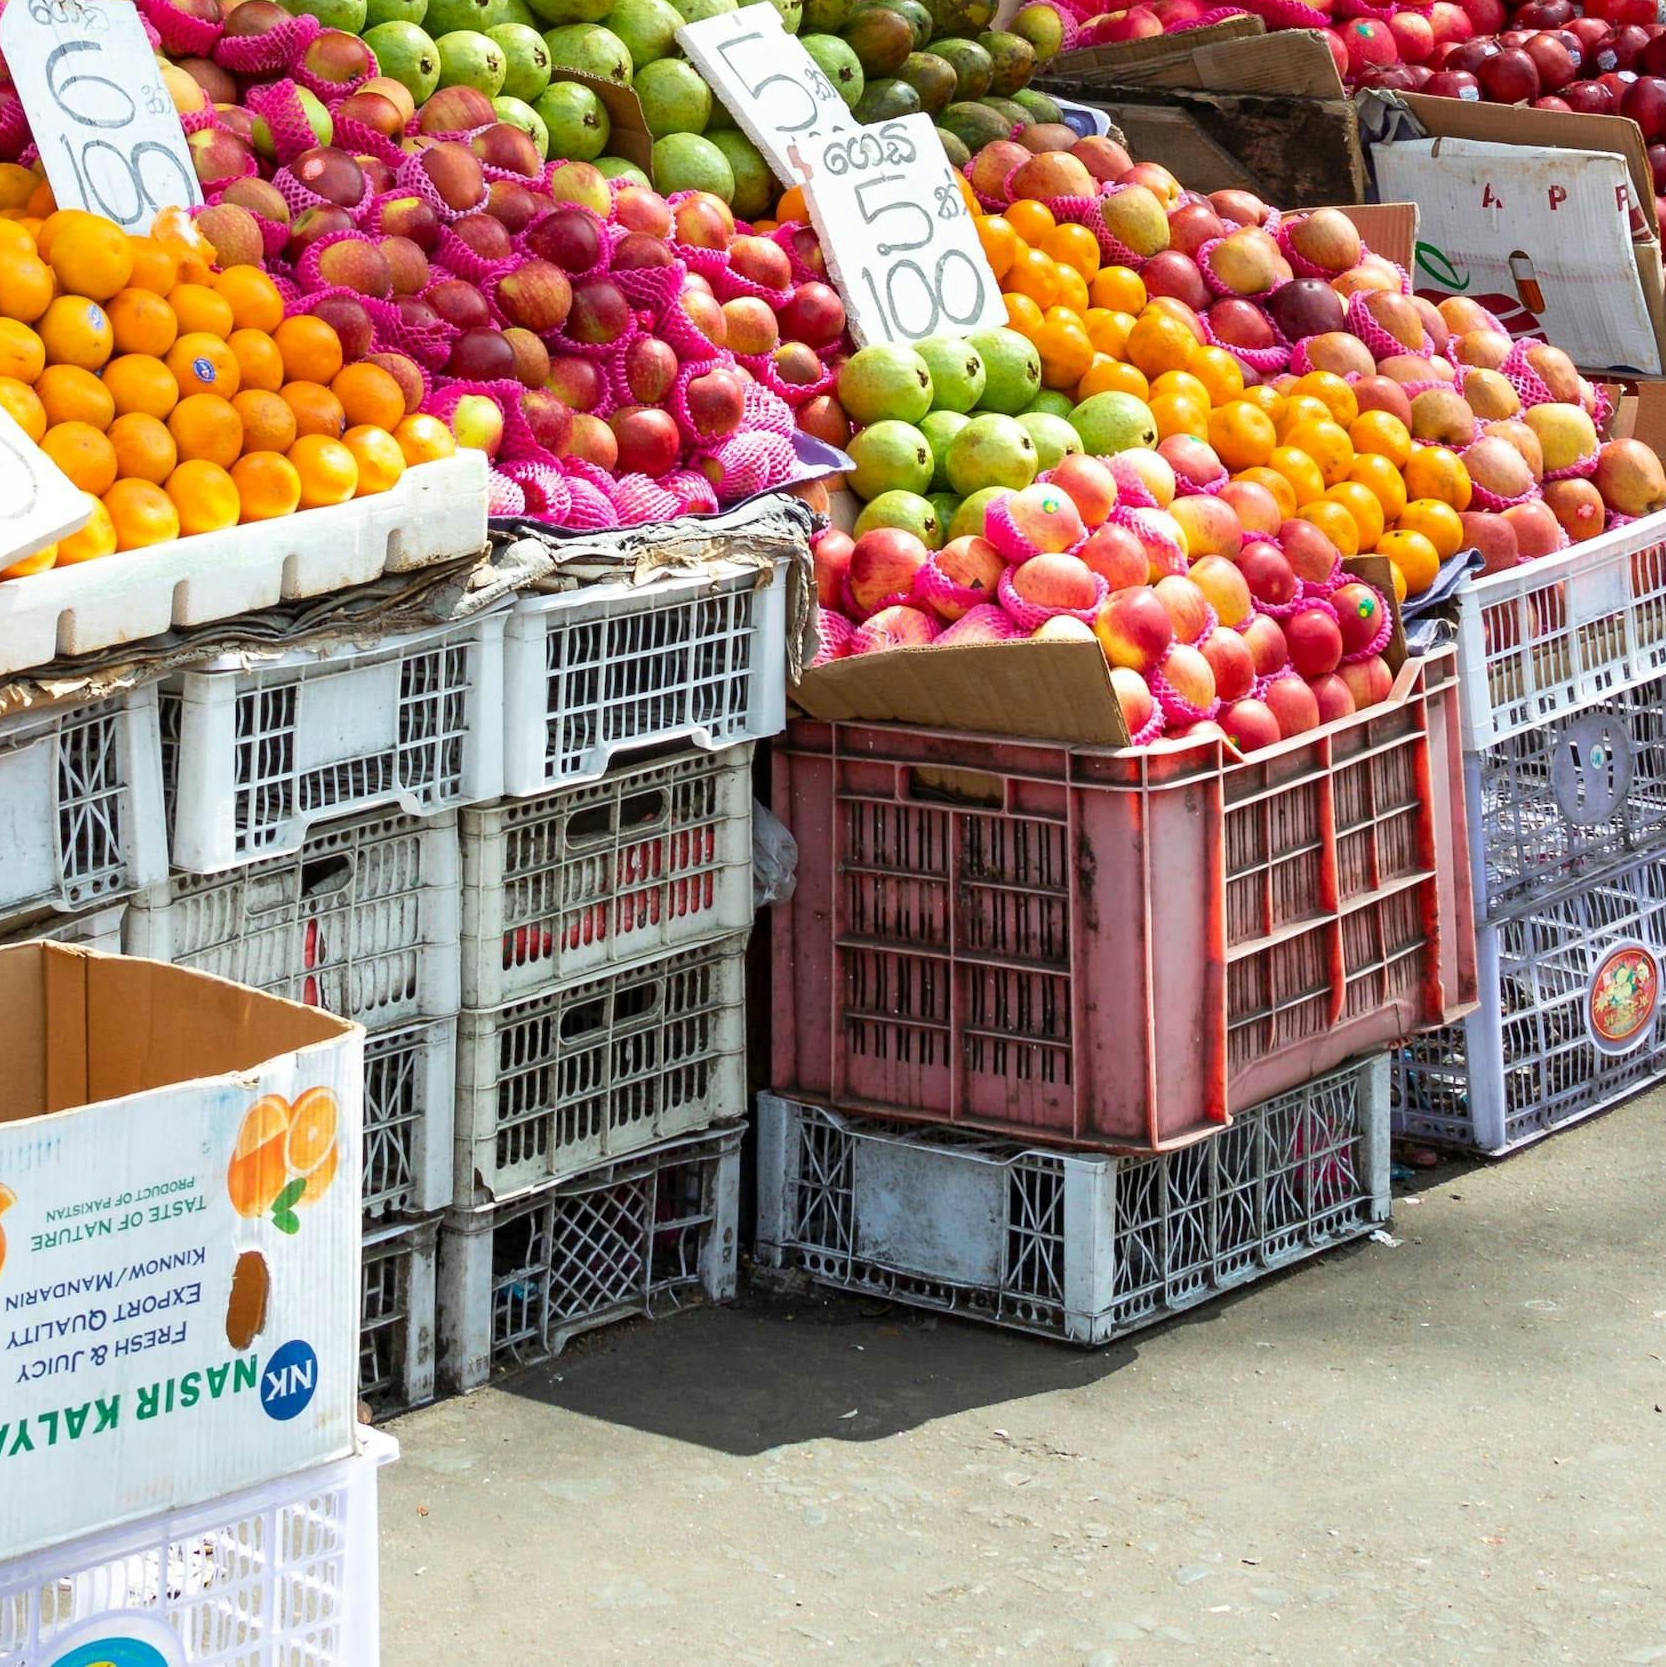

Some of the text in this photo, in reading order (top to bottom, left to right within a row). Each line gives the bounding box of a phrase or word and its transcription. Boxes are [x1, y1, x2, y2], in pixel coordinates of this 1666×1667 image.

[46, 40, 136, 128] 6
[716, 32, 819, 132] 5
[60, 133, 195, 226] 100
[854, 174, 934, 256] 5
[862, 249, 986, 342] 100
[31, 1195, 207, 1251] TASTE OF NATURE
[45, 1176, 195, 1222] PRODUCT OF PAKISTAN
[4, 1246, 206, 1311] KINNOW/MANDARIN
[6, 1282, 202, 1349] EXPORT QUALITY
[16, 1321, 188, 1383] FRESH & JUICY
[265, 1359, 313, 1403] NK
[136, 1354, 257, 1422] NASIR
